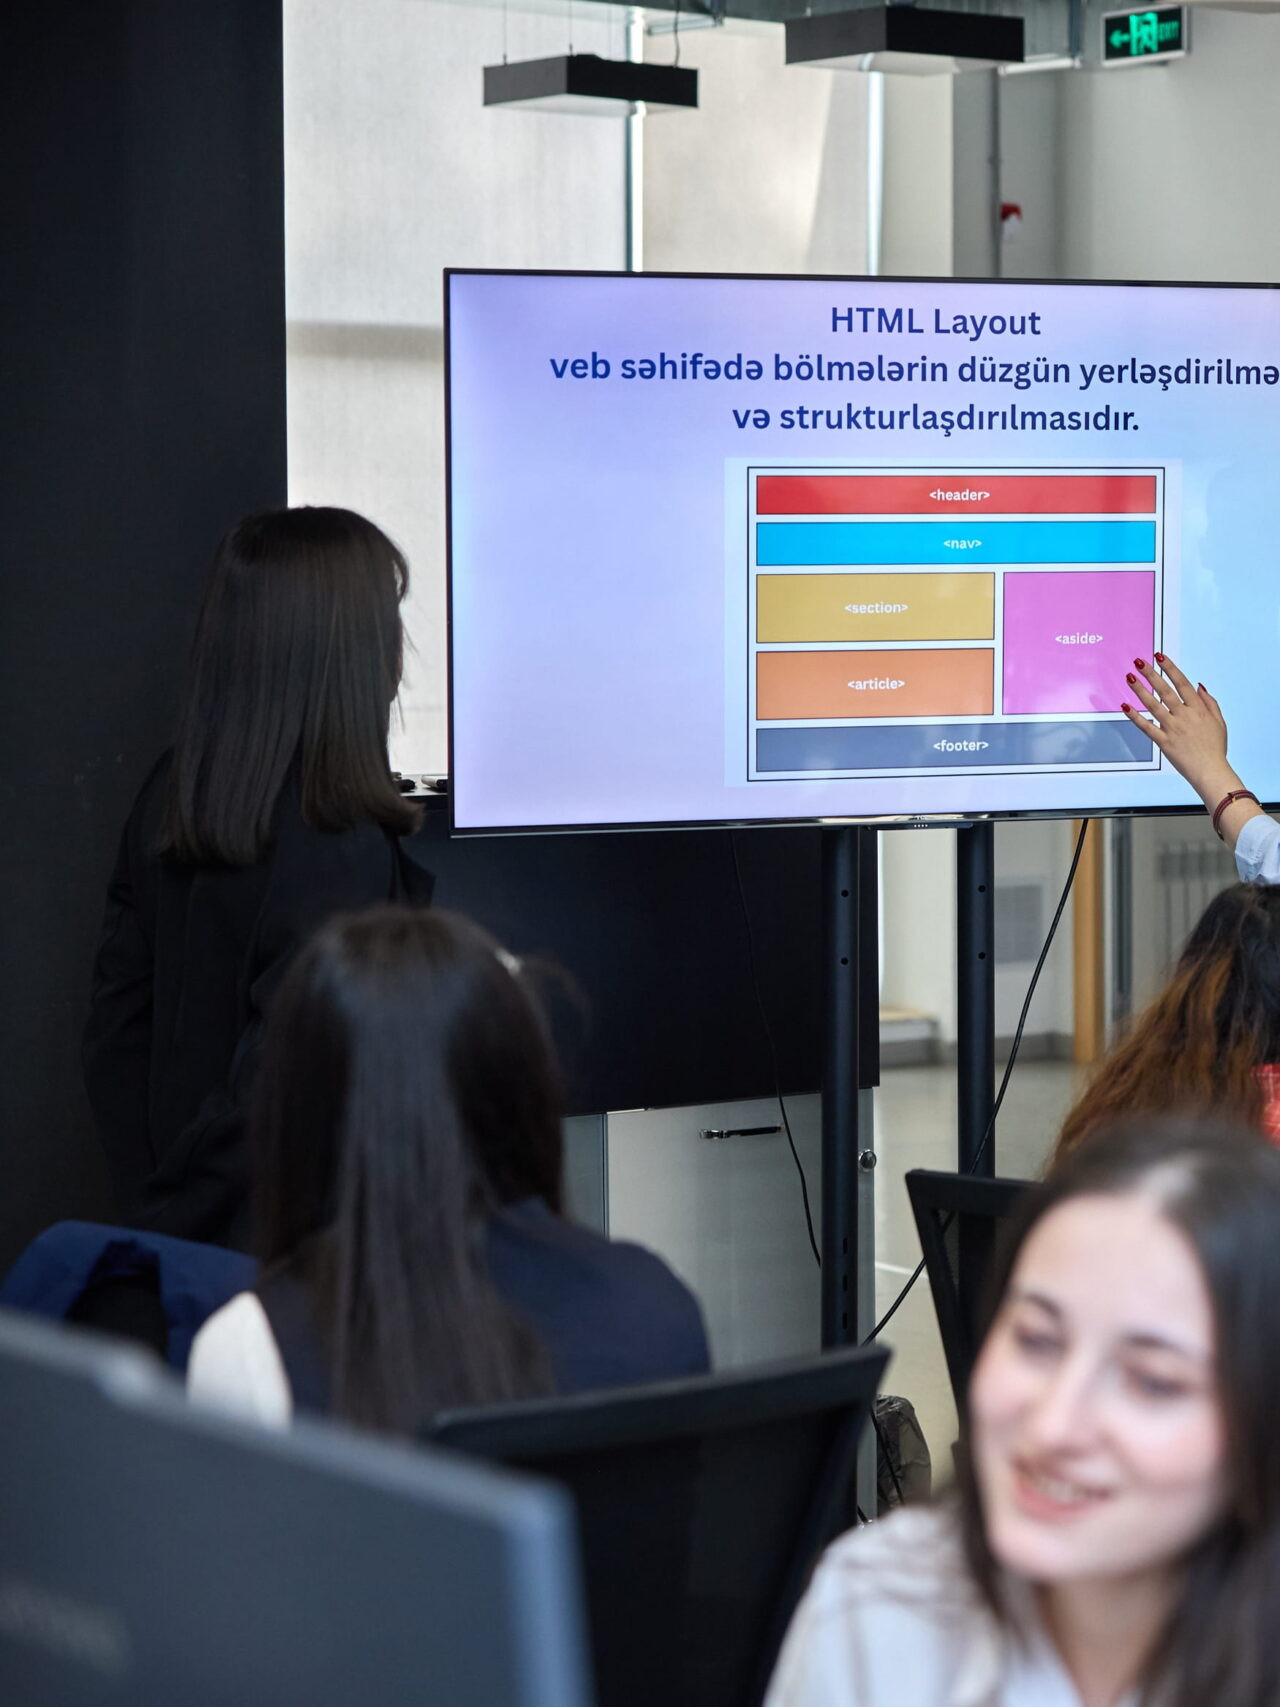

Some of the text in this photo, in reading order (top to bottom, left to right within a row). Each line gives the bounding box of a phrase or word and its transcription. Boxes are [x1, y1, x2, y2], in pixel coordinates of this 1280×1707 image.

[831, 306, 1042, 341] HTML Layout
[549, 351, 611, 380] veb
[620, 351, 764, 381] səhifədə
[774, 353, 948, 382] bölmələrin
[958, 355, 1070, 391] düzgün
[731, 402, 1140, 438] və strukturlaşdırılmasıdır.
[929, 487, 991, 503] <header>
[943, 538, 982, 551] <nav>
[844, 600, 909, 615] <section>
[1054, 630, 1103, 646] <aside>
[847, 676, 906, 692] <article>
[932, 738, 989, 753] <footer>
